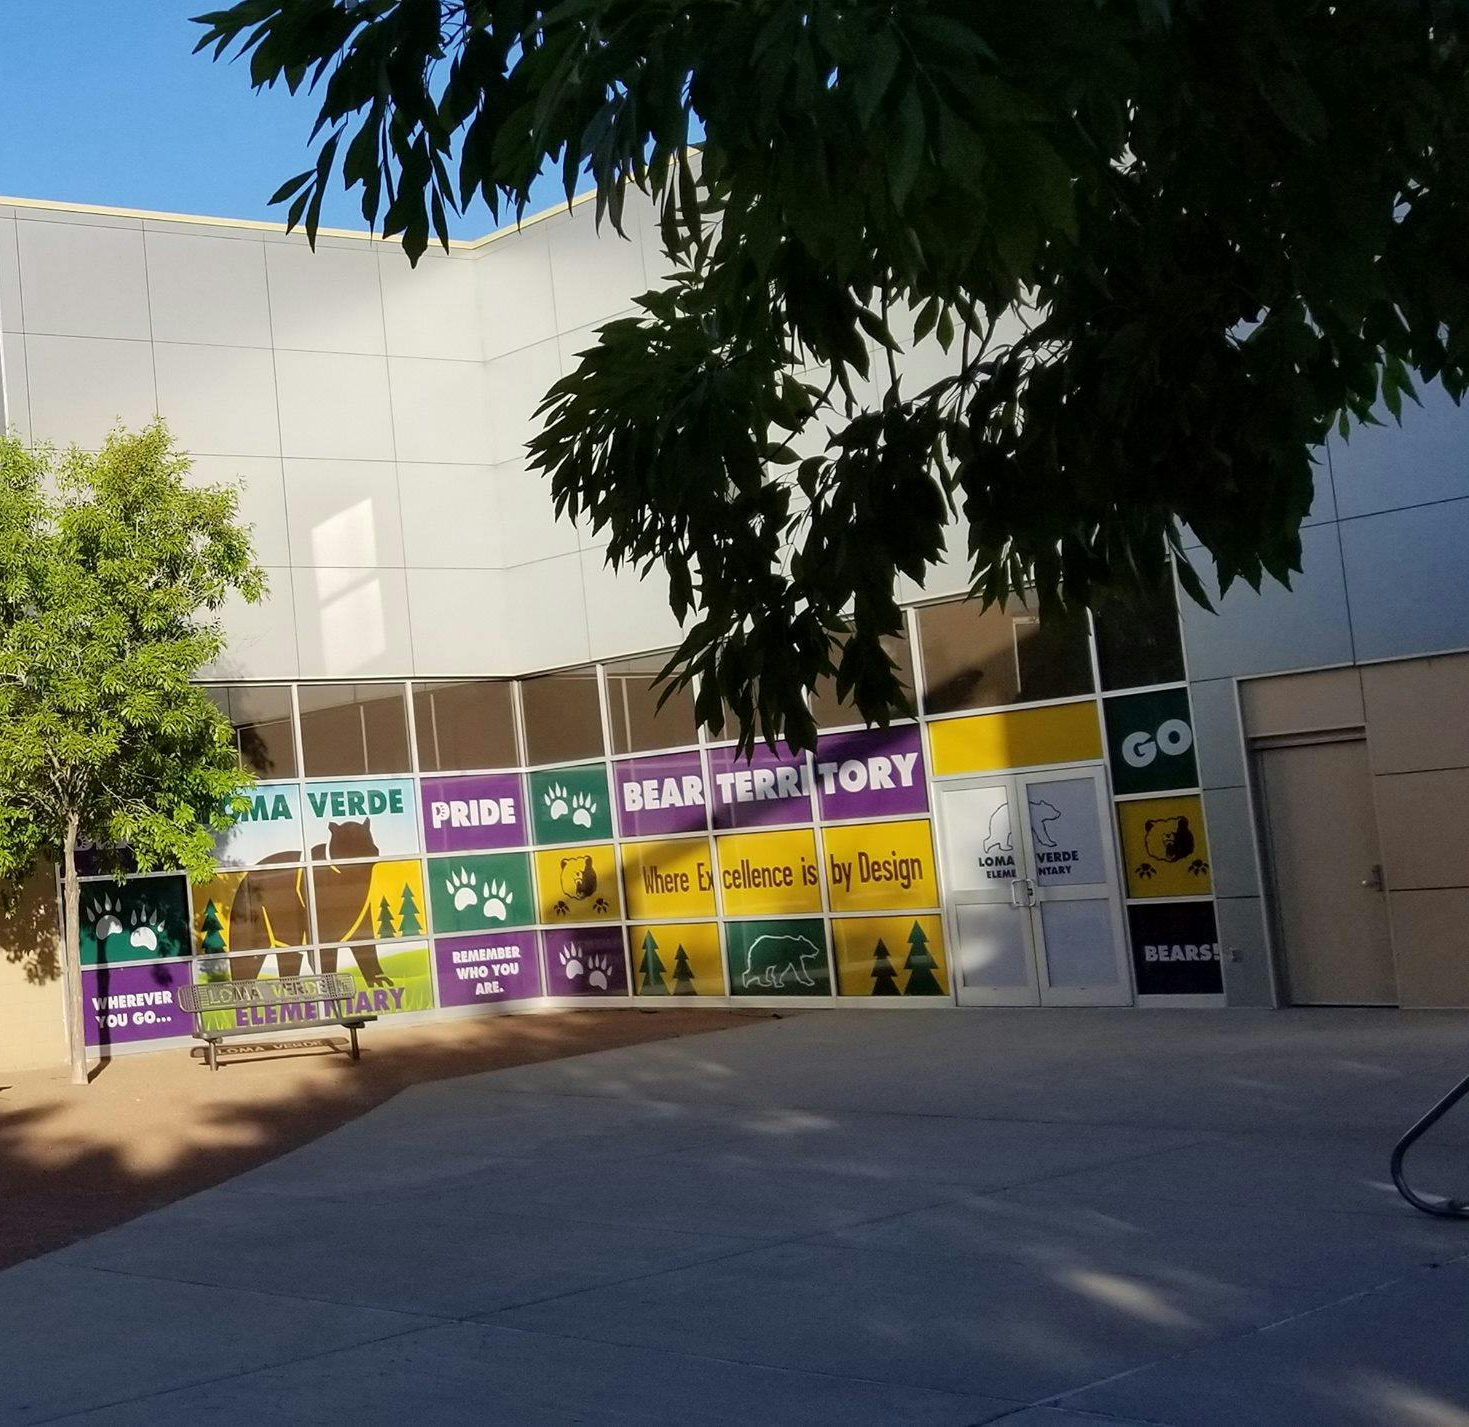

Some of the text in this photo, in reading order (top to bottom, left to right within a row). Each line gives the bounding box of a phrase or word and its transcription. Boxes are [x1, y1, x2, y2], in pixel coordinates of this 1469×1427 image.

[1121, 718, 1193, 768] GO
[623, 752, 919, 812] BEAR TERRITORY
[219, 787, 404, 822] OMA VERDE
[431, 798, 516, 829] PRIDE
[979, 850, 1079, 867] LOMA VERDE
[643, 850, 923, 894] Where Excellence is by Design
[452, 946, 522, 964] REMEMBER
[1144, 943, 1220, 961] BEARS!
[456, 962, 520, 980] WHO YOU
[209, 978, 328, 1006] LOMA VERDE
[475, 981, 504, 996] ARE.
[92, 991, 173, 1011] WHEREVER
[95, 1010, 172, 1028] YOU GO...
